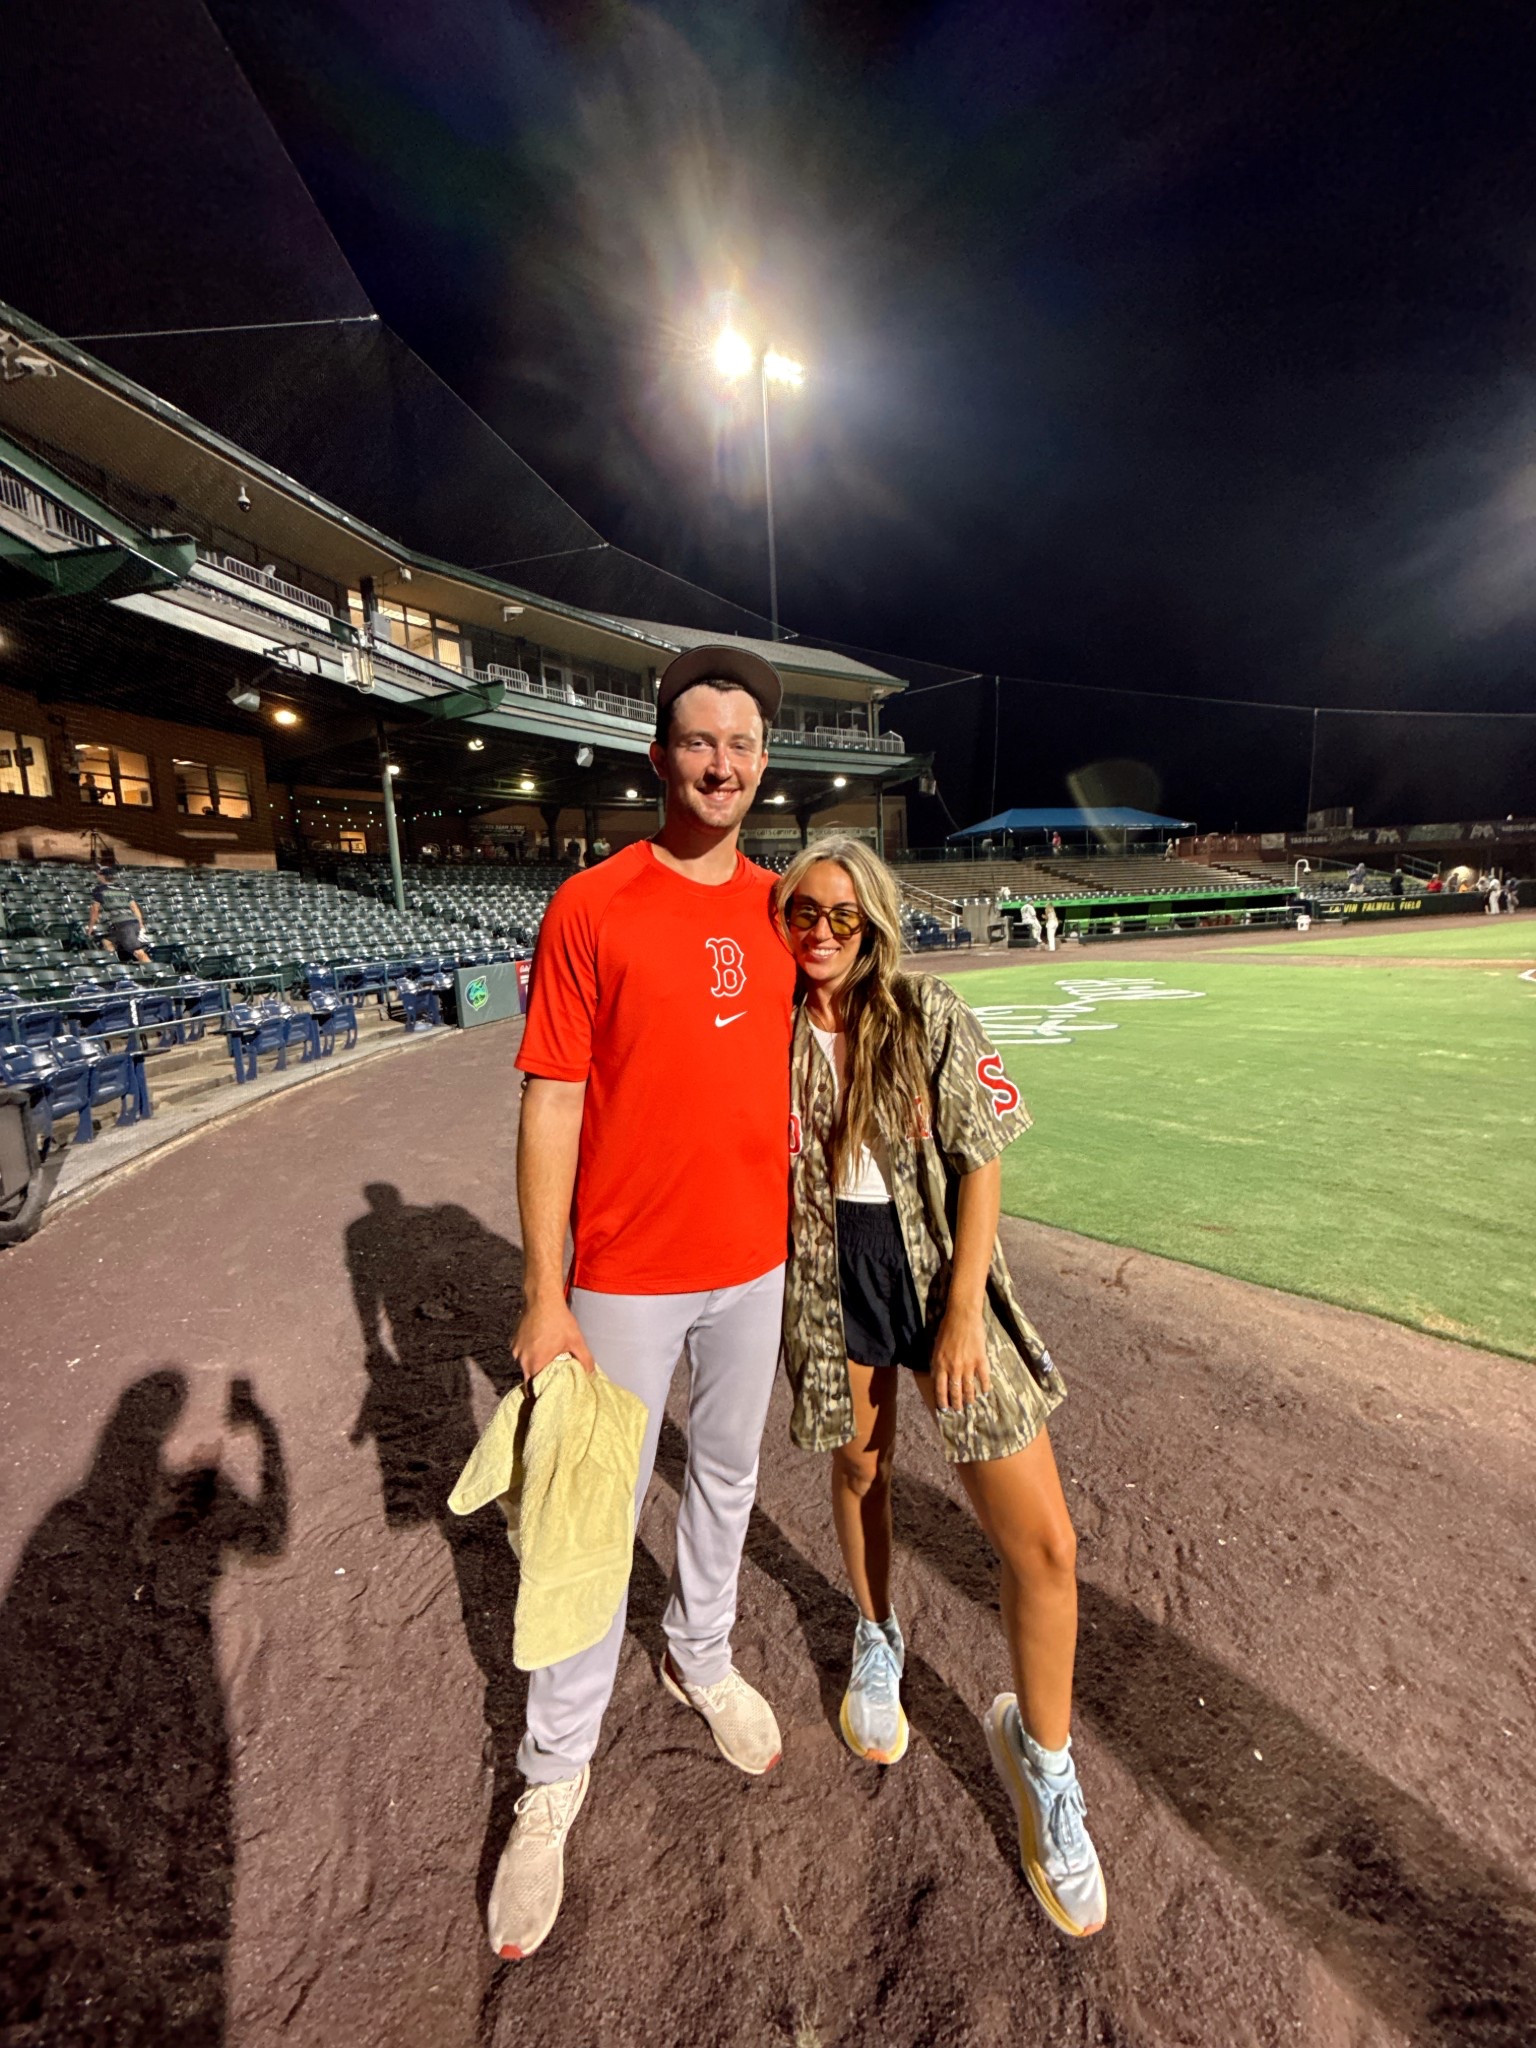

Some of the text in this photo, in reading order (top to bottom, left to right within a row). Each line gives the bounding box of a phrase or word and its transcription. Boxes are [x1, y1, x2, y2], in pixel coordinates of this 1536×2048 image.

[1362, 902, 1395, 912] FALWELL
[1400, 900, 1422, 911] FIELD
[705, 937, 747, 998] B
[976, 1050, 1021, 1121] S
